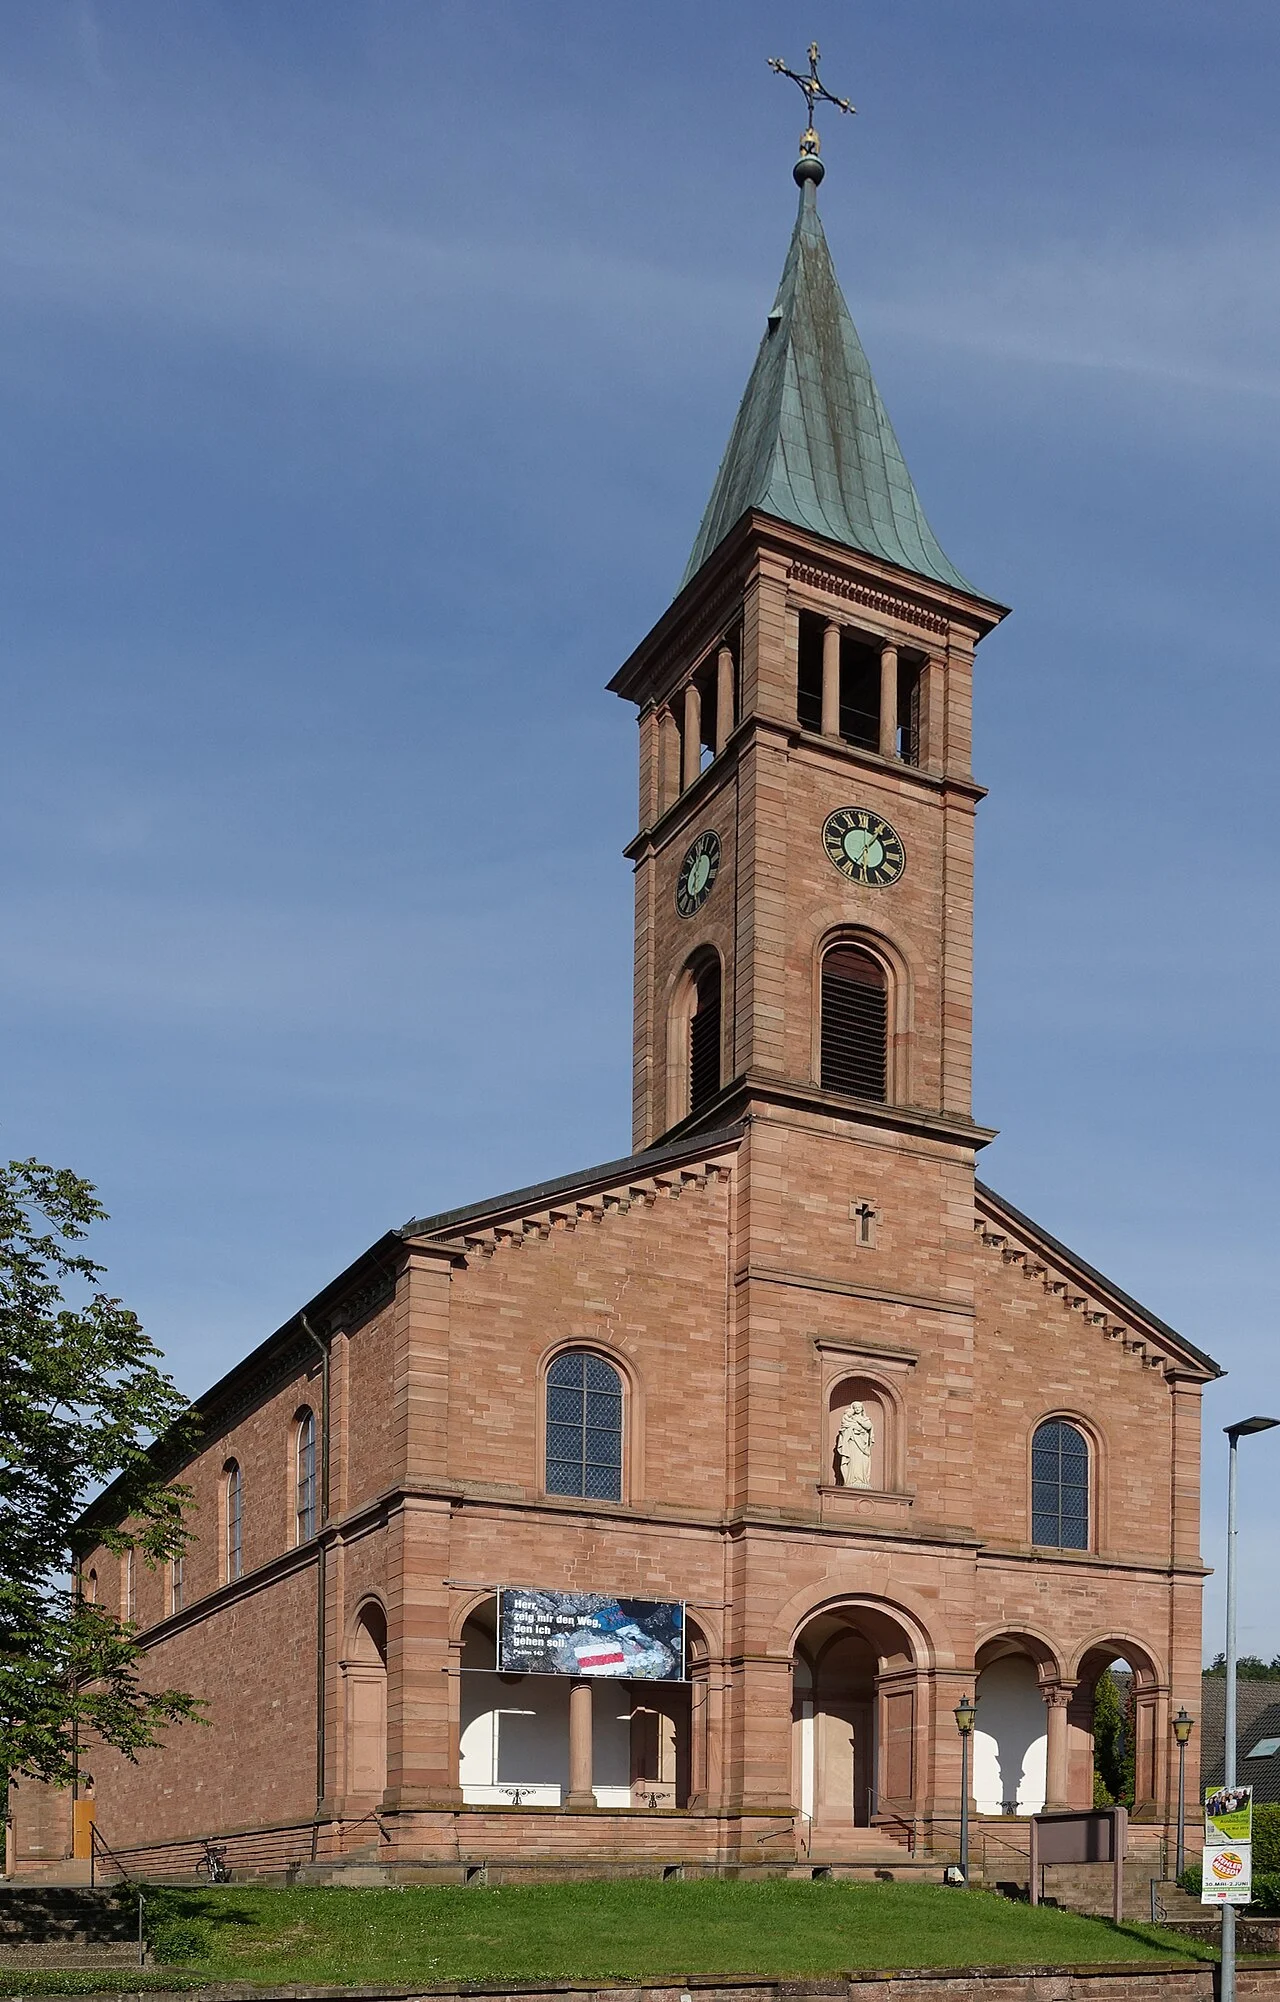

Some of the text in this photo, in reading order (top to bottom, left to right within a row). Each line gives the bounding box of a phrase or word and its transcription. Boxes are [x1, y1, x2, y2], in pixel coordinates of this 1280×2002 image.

[514, 1599, 538, 1611] Herr,
[514, 1613, 602, 1628] zeig mir den Weg,
[514, 1624, 532, 1634] den
[513, 1637, 568, 1648] gehen soll.
[1216, 1854, 1242, 1870] KEHLER
